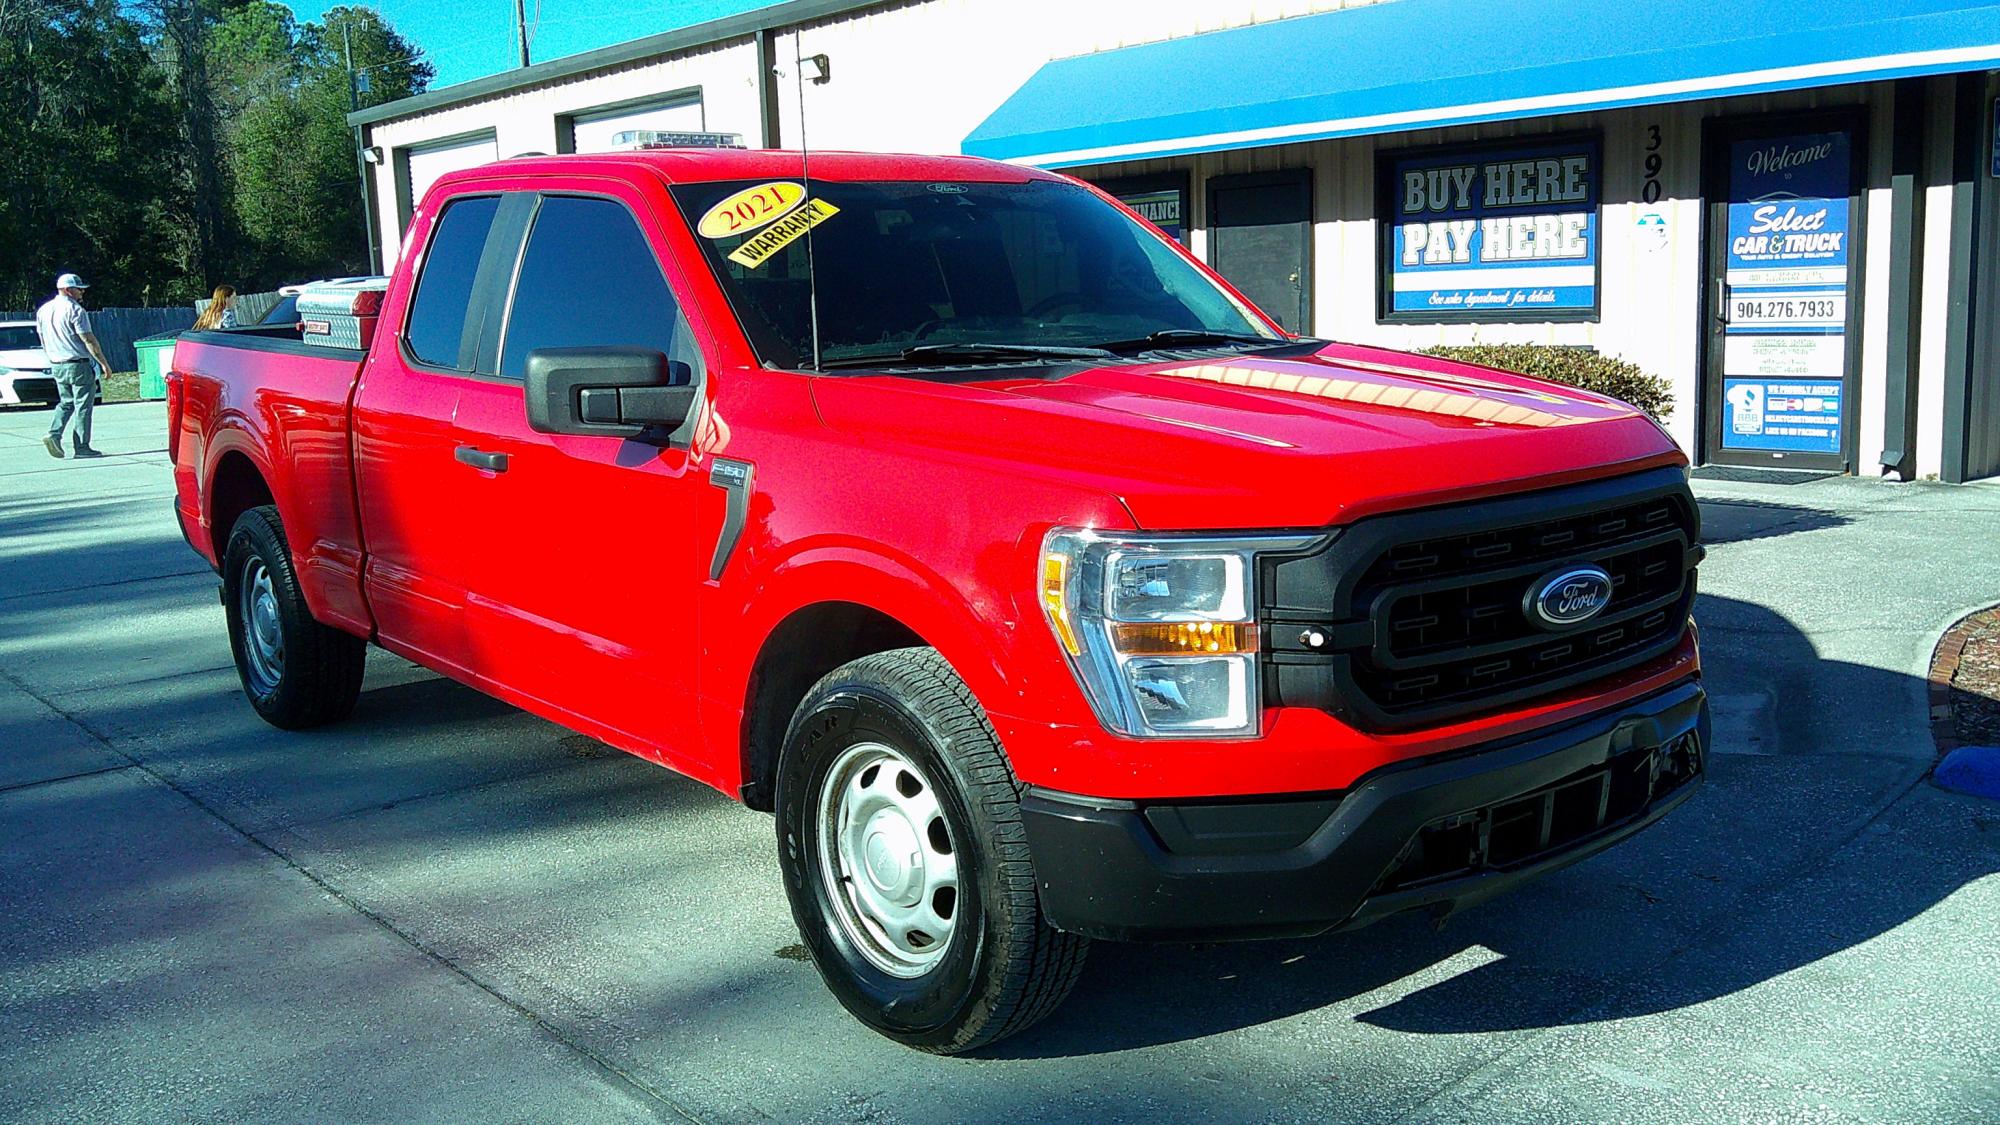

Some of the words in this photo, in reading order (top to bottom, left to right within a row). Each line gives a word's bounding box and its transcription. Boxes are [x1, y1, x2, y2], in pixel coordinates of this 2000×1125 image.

[1642, 124, 1662, 205] 390
[1747, 142, 1832, 177] Welcome
[1403, 165, 1477, 213] BUY
[1483, 156, 1588, 208] HERE
[719, 186, 786, 231] 2021
[1749, 205, 1827, 234] Select
[739, 202, 825, 261] WARRANTY
[1402, 219, 1477, 266] PAY
[1480, 213, 1588, 262] HERE
[1732, 236, 1769, 255] CAR
[1768, 235, 1784, 254] &
[1784, 232, 1844, 253] TRUCK
[1428, 291, 1444, 305] See
[1464, 291, 1510, 308] department
[1507, 291, 1525, 307] for
[1737, 301, 1834, 319] 904.276.7933
[1558, 582, 1599, 614] Ford
